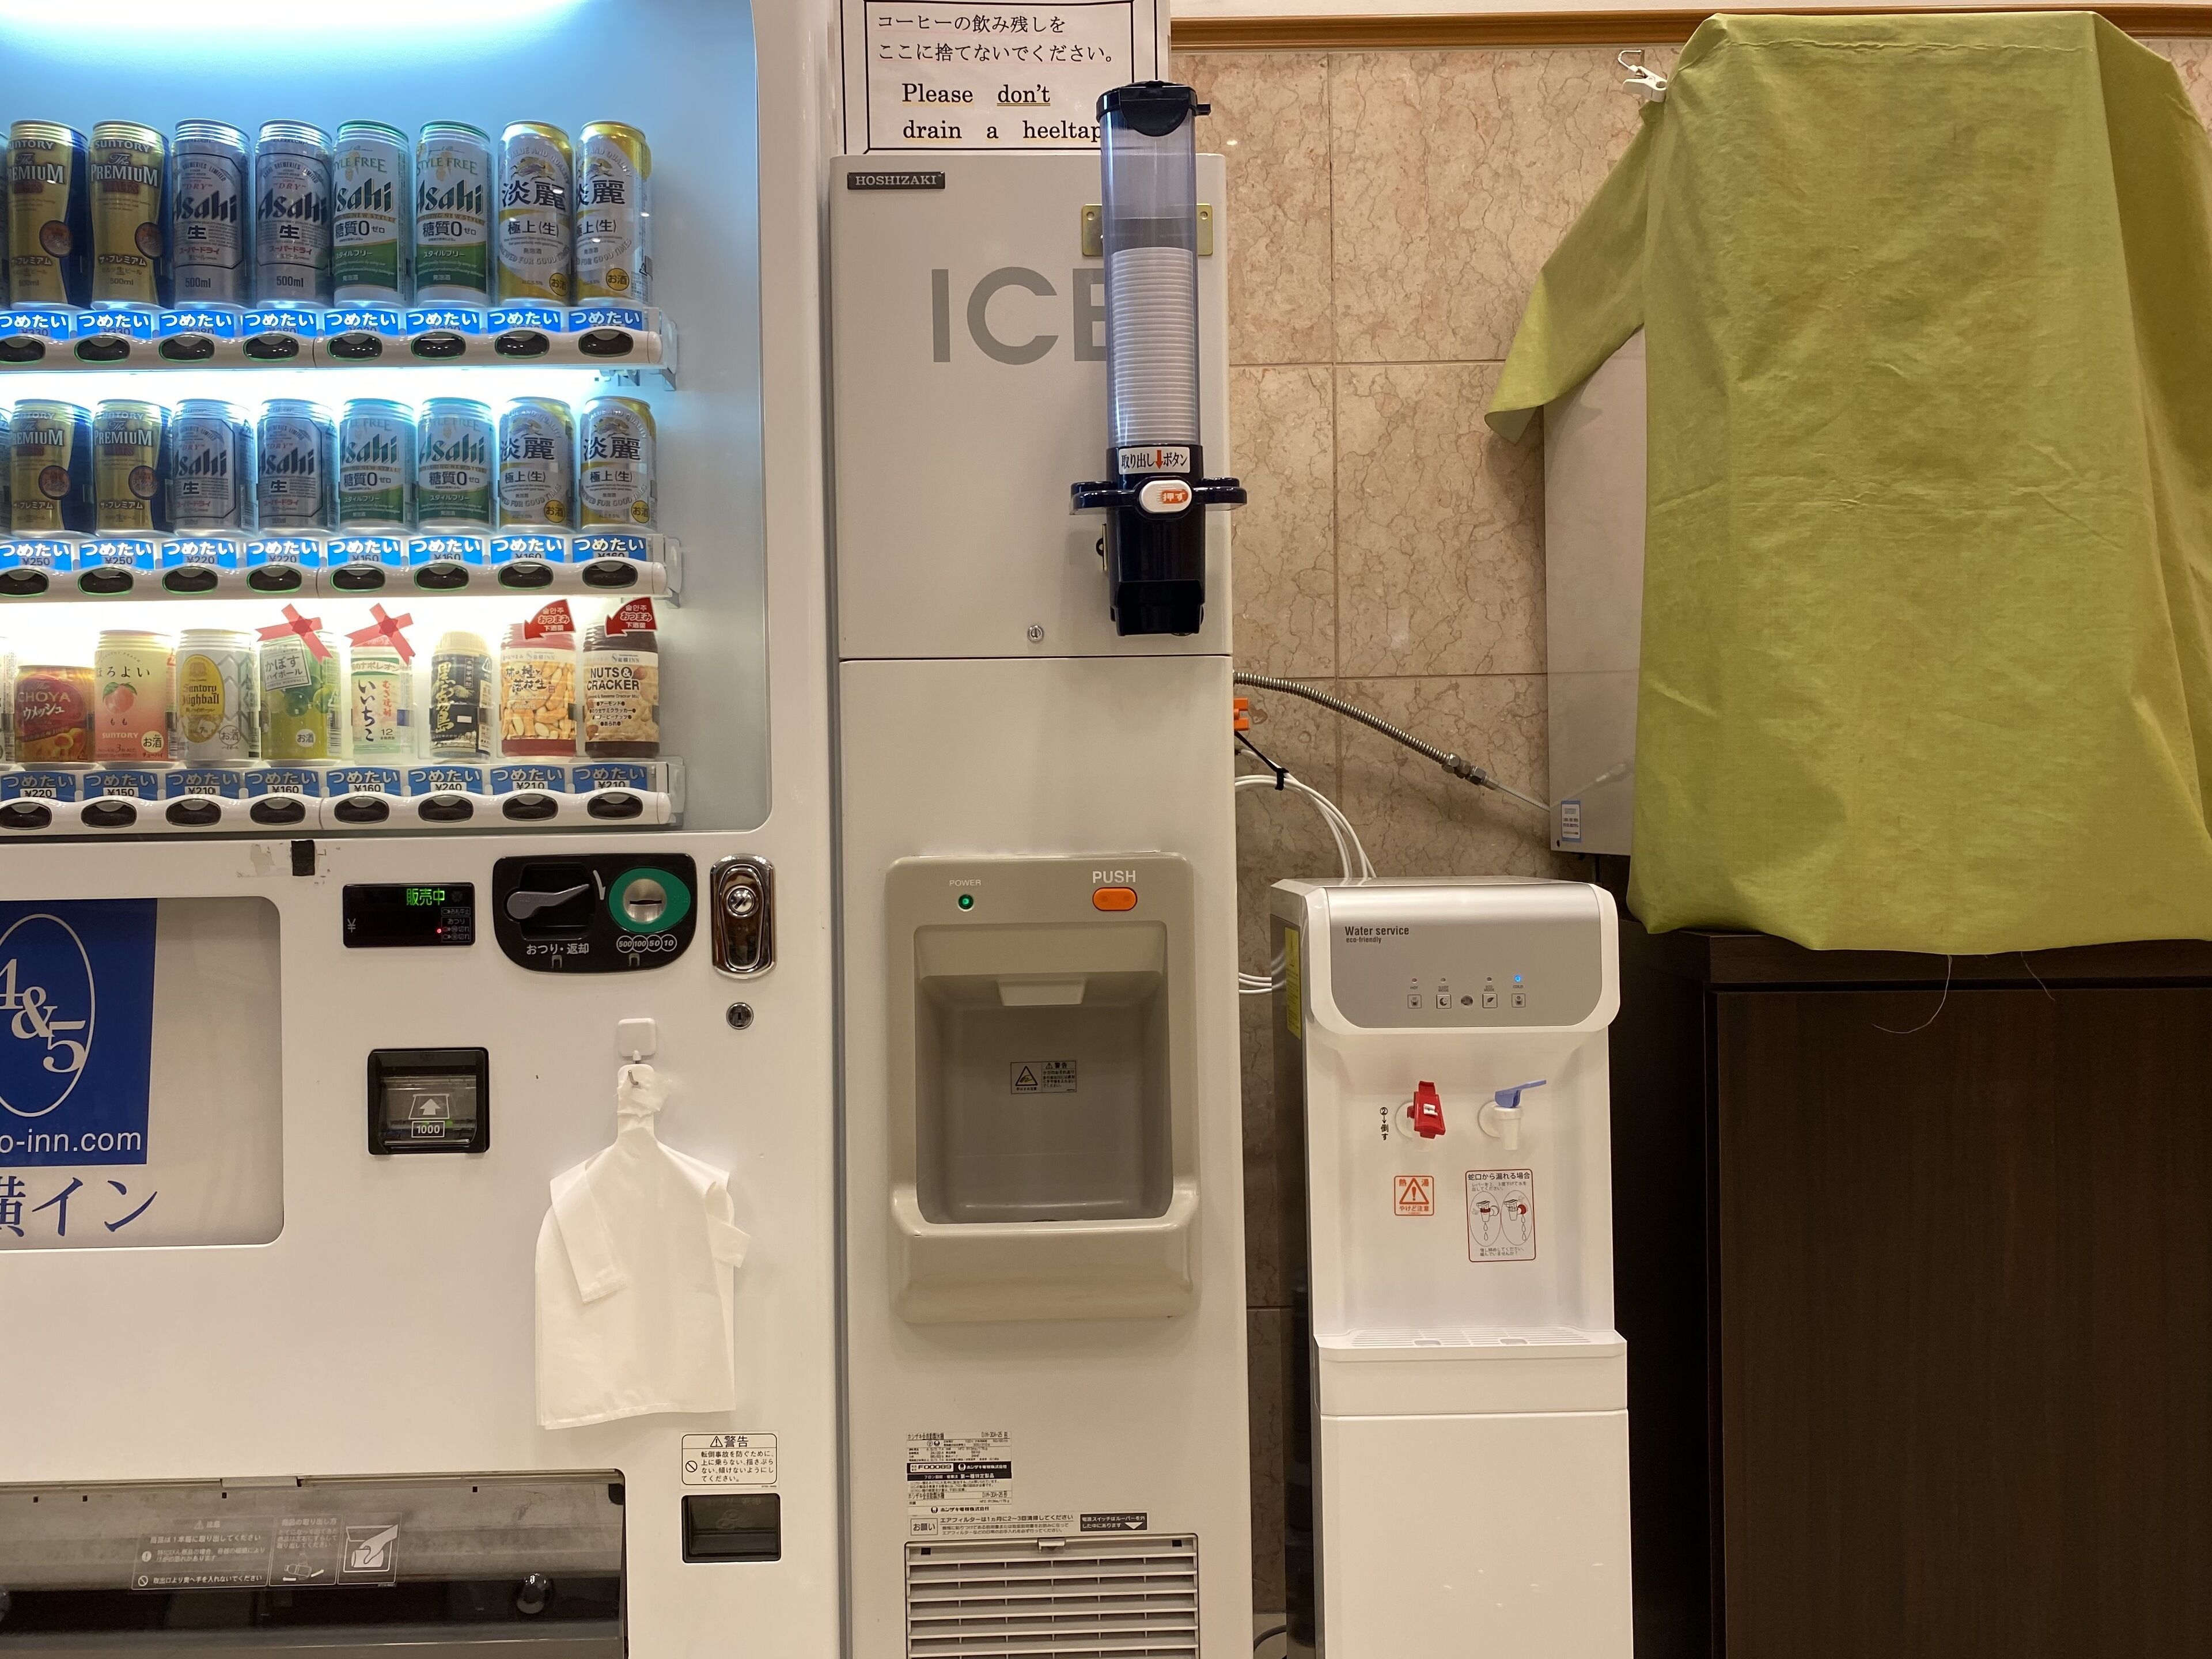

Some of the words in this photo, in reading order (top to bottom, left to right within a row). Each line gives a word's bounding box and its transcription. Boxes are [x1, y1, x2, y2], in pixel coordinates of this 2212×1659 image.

[878, 15, 1065, 33] コーヒーの飲み残しを
[878, 43, 1115, 63] ここに捨てないでください。
[902, 83, 974, 103] Please
[997, 85, 1050, 103] don't
[903, 120, 962, 139] drain
[987, 125, 999, 139] a
[108, 153, 131, 165] The
[354, 157, 387, 173] FREE
[446, 157, 478, 175] FREE
[91, 164, 157, 187] PREMIUM
[209, 165, 226, 181] LIMITED
[855, 176, 937, 185] HOSHIZAKI
[502, 180, 566, 211] 淡麗
[259, 188, 328, 225] Asahi
[188, 225, 206, 240] 生
[279, 225, 300, 240] 生
[422, 221, 462, 237] 糖質0
[508, 220, 559, 238] 極上(生)
[269, 246, 312, 255] スーパードライ
[336, 251, 373, 259] スタイルフリー
[424, 250, 465, 258] スタイルフリー
[593, 253, 613, 264] GOOD
[185, 278, 211, 288] 500ml
[276, 276, 304, 287] 500ml
[608, 275, 627, 285] お酒
[1, 315, 67, 328] つめたい
[79, 315, 149, 328] つめたい
[161, 313, 232, 327] つめたい
[245, 313, 315, 327] つめたい
[326, 312, 396, 327] つめたい
[408, 312, 478, 326] つめたい
[489, 311, 559, 325] つめたい
[571, 311, 641, 325] つめたい
[932, 267, 1108, 365] ICE
[94, 430, 152, 446] PREMIUM
[419, 434, 484, 465] Asahi
[501, 437, 555, 461] 淡麗
[584, 437, 641, 461] 淡麗
[1122, 453, 1154, 469] 取り出し
[1163, 452, 1188, 467] ボタン
[429, 472, 467, 485] 糖質0
[505, 471, 546, 483] 極上(生)
[590, 471, 632, 483] 極上(生)
[183, 481, 200, 494] 生
[270, 479, 288, 493] 生
[525, 497, 545, 506] GOOD
[613, 497, 632, 506] GOOD
[1163, 490, 1186, 502] 押す
[100, 501, 143, 509] ザ・プレミアム
[546, 506, 564, 517] お酒
[633, 506, 649, 517] お酒
[1, 543, 70, 557] つめたい
[81, 543, 151, 556] つめたい
[164, 541, 234, 555] つめたい
[248, 540, 317, 555] つめたい
[329, 540, 399, 554] つめたい
[411, 539, 480, 553] つめたい
[493, 538, 562, 552] つめたい
[574, 538, 644, 551] つめたい
[22, 558, 50, 566] ¥250
[105, 556, 132, 565] ¥250
[538, 615, 570, 624] おつまみ
[620, 612, 652, 621] おつまみ
[265, 656, 300, 672] かぼす
[96, 666, 150, 678] ほろよい
[267, 669, 302, 680] ハイボール
[590, 667, 619, 679] NUTS
[621, 667, 632, 679] &
[184, 684, 217, 695] Suntory
[587, 679, 639, 691] CRACKER
[18, 692, 71, 702] CHOYA
[182, 694, 219, 707] Highball
[23, 703, 65, 721] ウメッシュ
[358, 679, 376, 741] いいちこ
[110, 718, 128, 726] もも
[143, 737, 162, 748] お酒
[221, 732, 240, 741] お酒
[297, 734, 314, 743] お酒
[168, 773, 238, 785] つめたい
[247, 772, 316, 785] つめたい
[329, 771, 399, 783] つめたい
[411, 770, 481, 783] つめたい
[493, 768, 562, 781] つめたい
[575, 767, 645, 780] つめたい
[3, 774, 73, 787] つめたい
[86, 774, 157, 787] つめたい
[25, 789, 52, 797] ¥220
[1092, 870, 1136, 883] PUSH
[406, 888, 445, 906] 販売中
[347, 918, 356, 933] ¥
[1345, 926, 1373, 936] Water
[1376, 926, 1409, 935] service
[1346, 936, 1382, 944] eco-friendly
[526, 943, 589, 955] おつり・返却
[416, 1125, 440, 1134] 1000
[1468, 1172, 1530, 1180] 蛇口から漏れる場合
[724, 1435, 748, 1447] 警告
[913, 1523, 935, 1531] お願い
